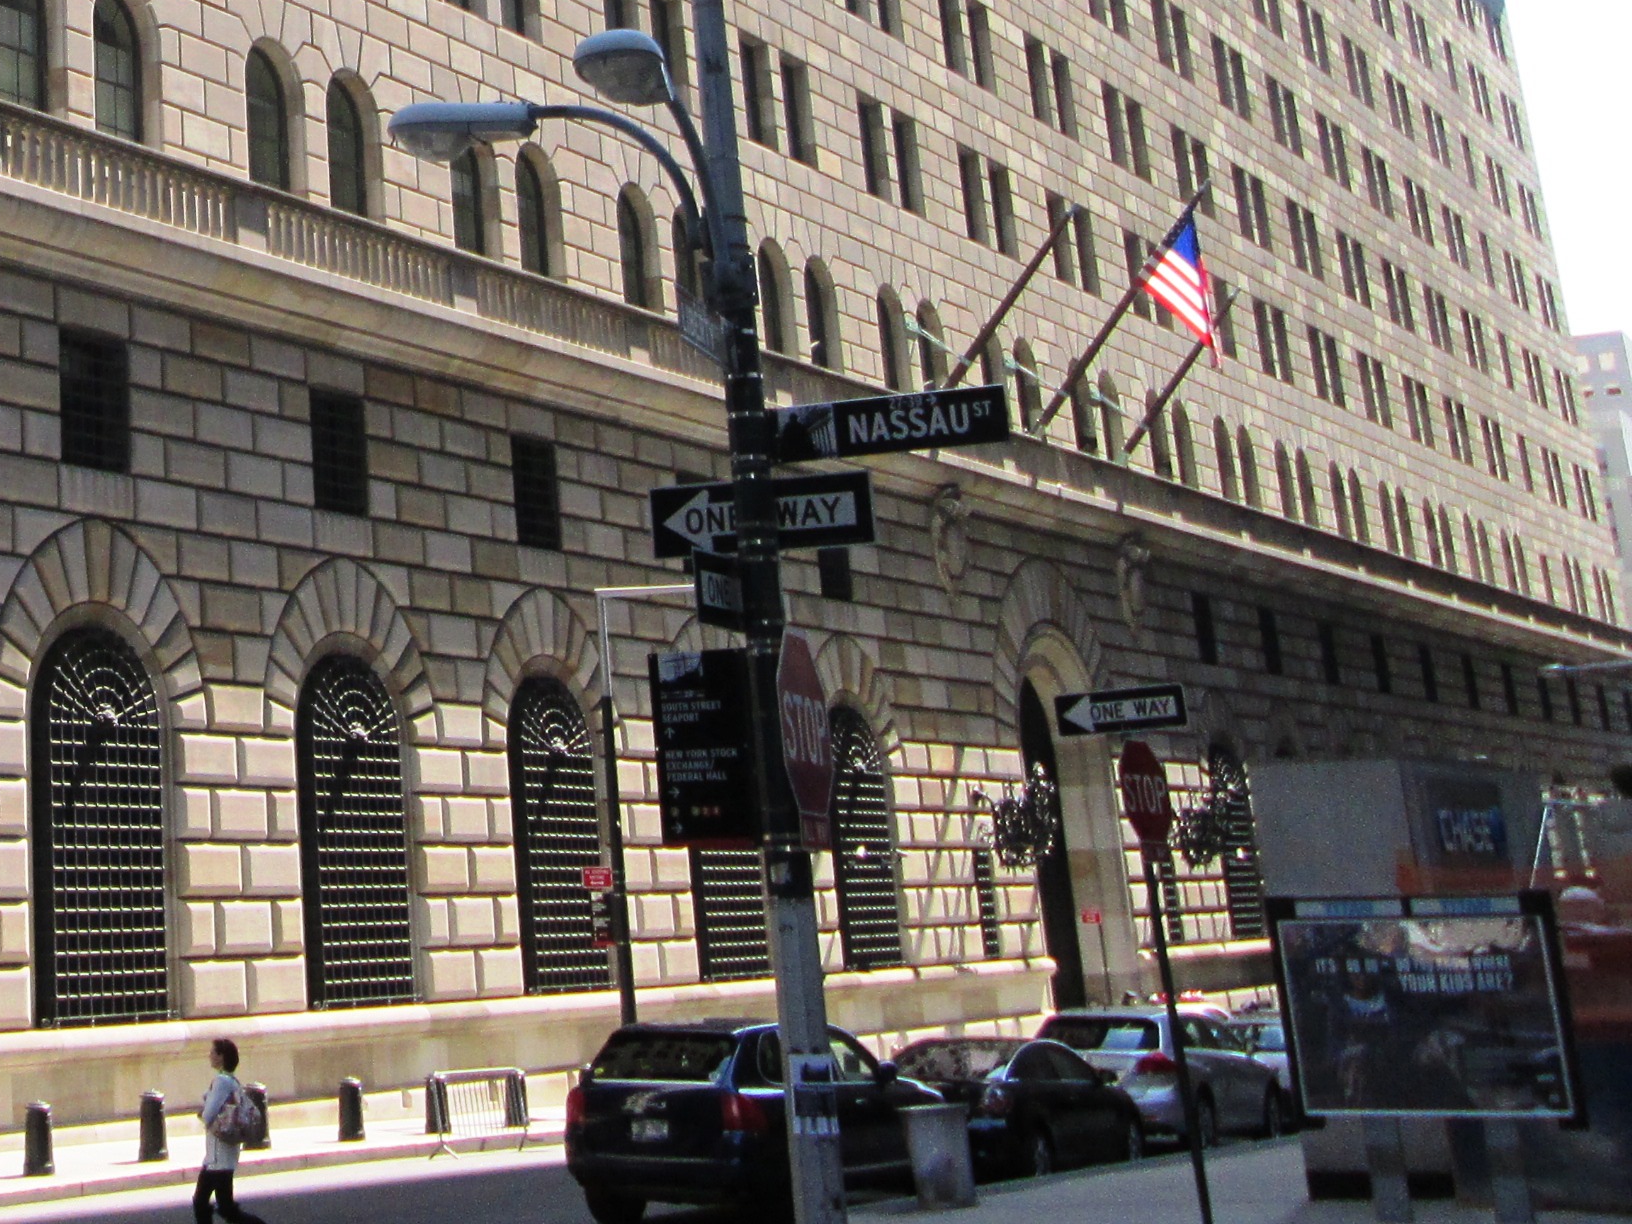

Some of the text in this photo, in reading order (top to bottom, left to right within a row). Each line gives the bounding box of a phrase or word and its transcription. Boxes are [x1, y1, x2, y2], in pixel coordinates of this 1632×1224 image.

[848, 399, 992, 444] NASSAU ST
[684, 495, 842, 535] ONE WAY
[661, 700, 722, 713] SOUTH STREET
[1090, 698, 1169, 720] ONE WAY
[662, 712, 700, 723] SEAPORT
[783, 690, 829, 767] STOP
[665, 747, 738, 759] NEW YORK STOCK
[667, 770, 728, 782] FEDERAL HALL
[1123, 775, 1166, 814] STOP
[1399, 973, 1435, 992] YOUR
